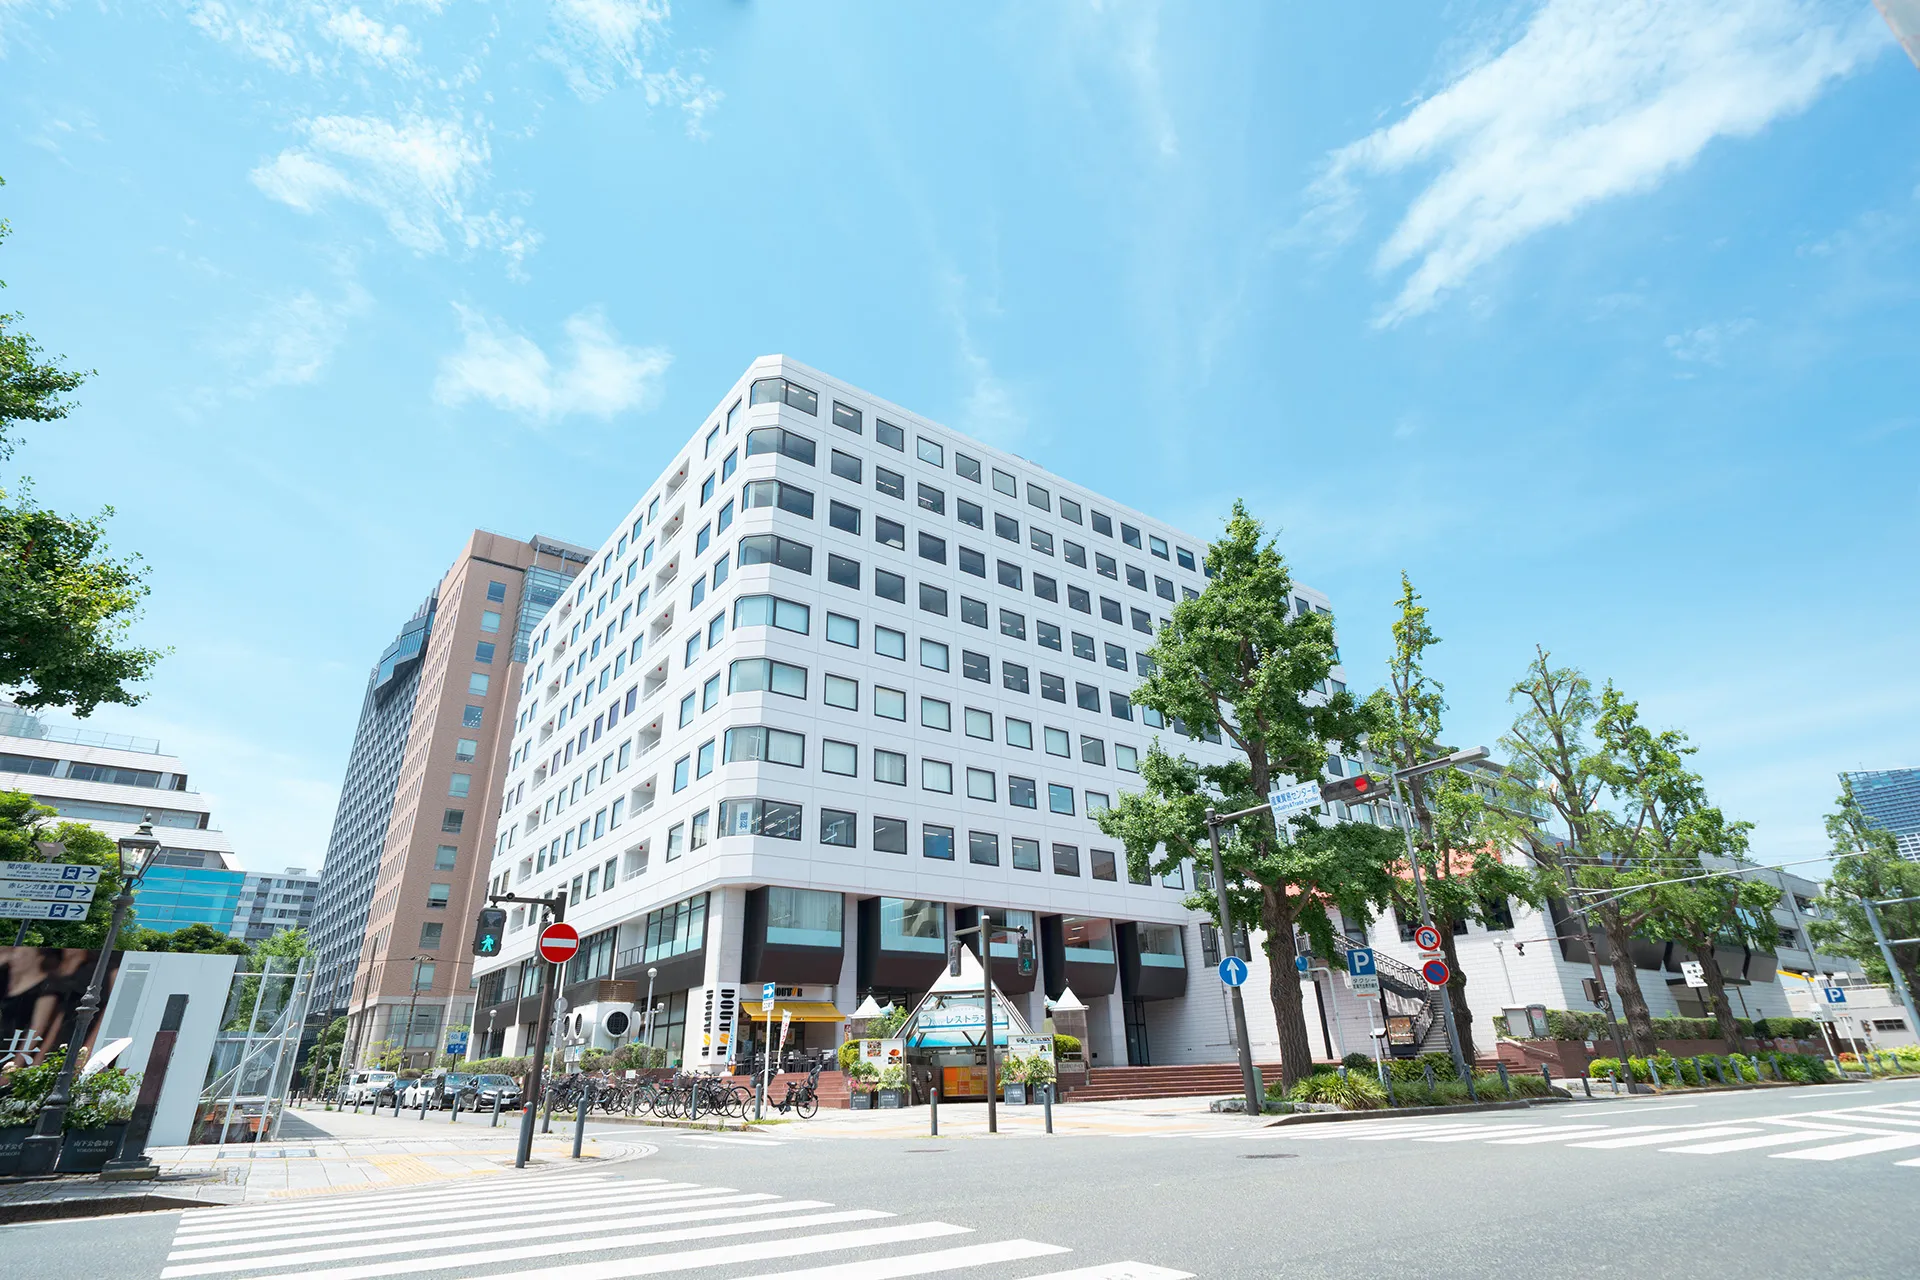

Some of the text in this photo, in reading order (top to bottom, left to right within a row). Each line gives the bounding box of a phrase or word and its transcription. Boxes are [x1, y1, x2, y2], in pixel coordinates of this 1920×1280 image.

[8, 882, 56, 890] 赤レンガ倉庫
[0, 901, 23, 909] 通り駅
[1353, 951, 1370, 973] P
[775, 984, 803, 997] OUTOR
[1828, 989, 1841, 1002] P
[0, 1029, 43, 1065] 共
